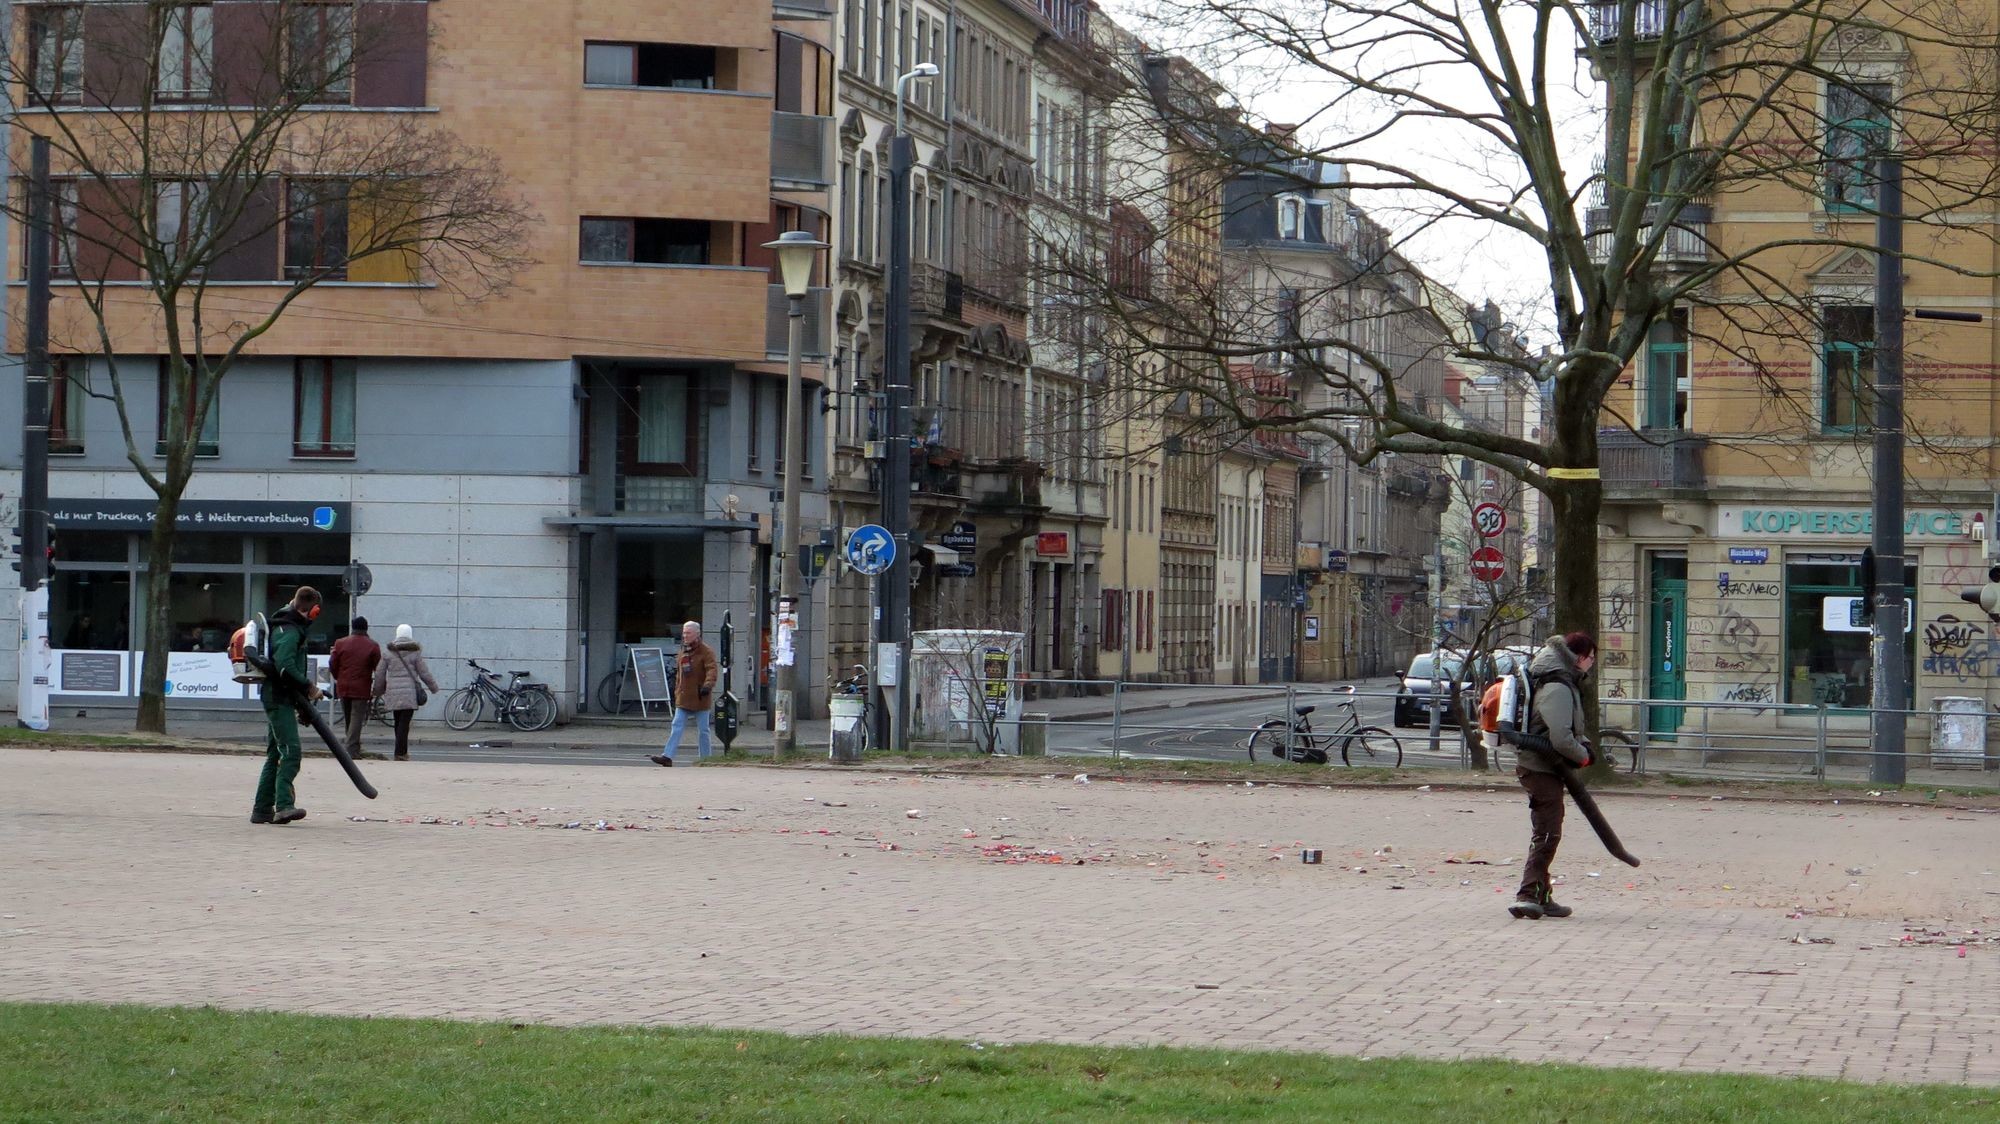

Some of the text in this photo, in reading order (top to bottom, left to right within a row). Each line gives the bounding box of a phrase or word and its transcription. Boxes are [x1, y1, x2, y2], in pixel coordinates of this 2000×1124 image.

[53, 511, 70, 521] als
[72, 513, 93, 521] nur
[97, 511, 143, 523] Drucken,
[146, 512, 190, 522] Scen
[208, 512, 310, 526] Weiterverarbeitung
[1479, 511, 1500, 529] 30
[1742, 510, 1963, 535] KOPIERSEVICE
[176, 682, 219, 694] Copyland
